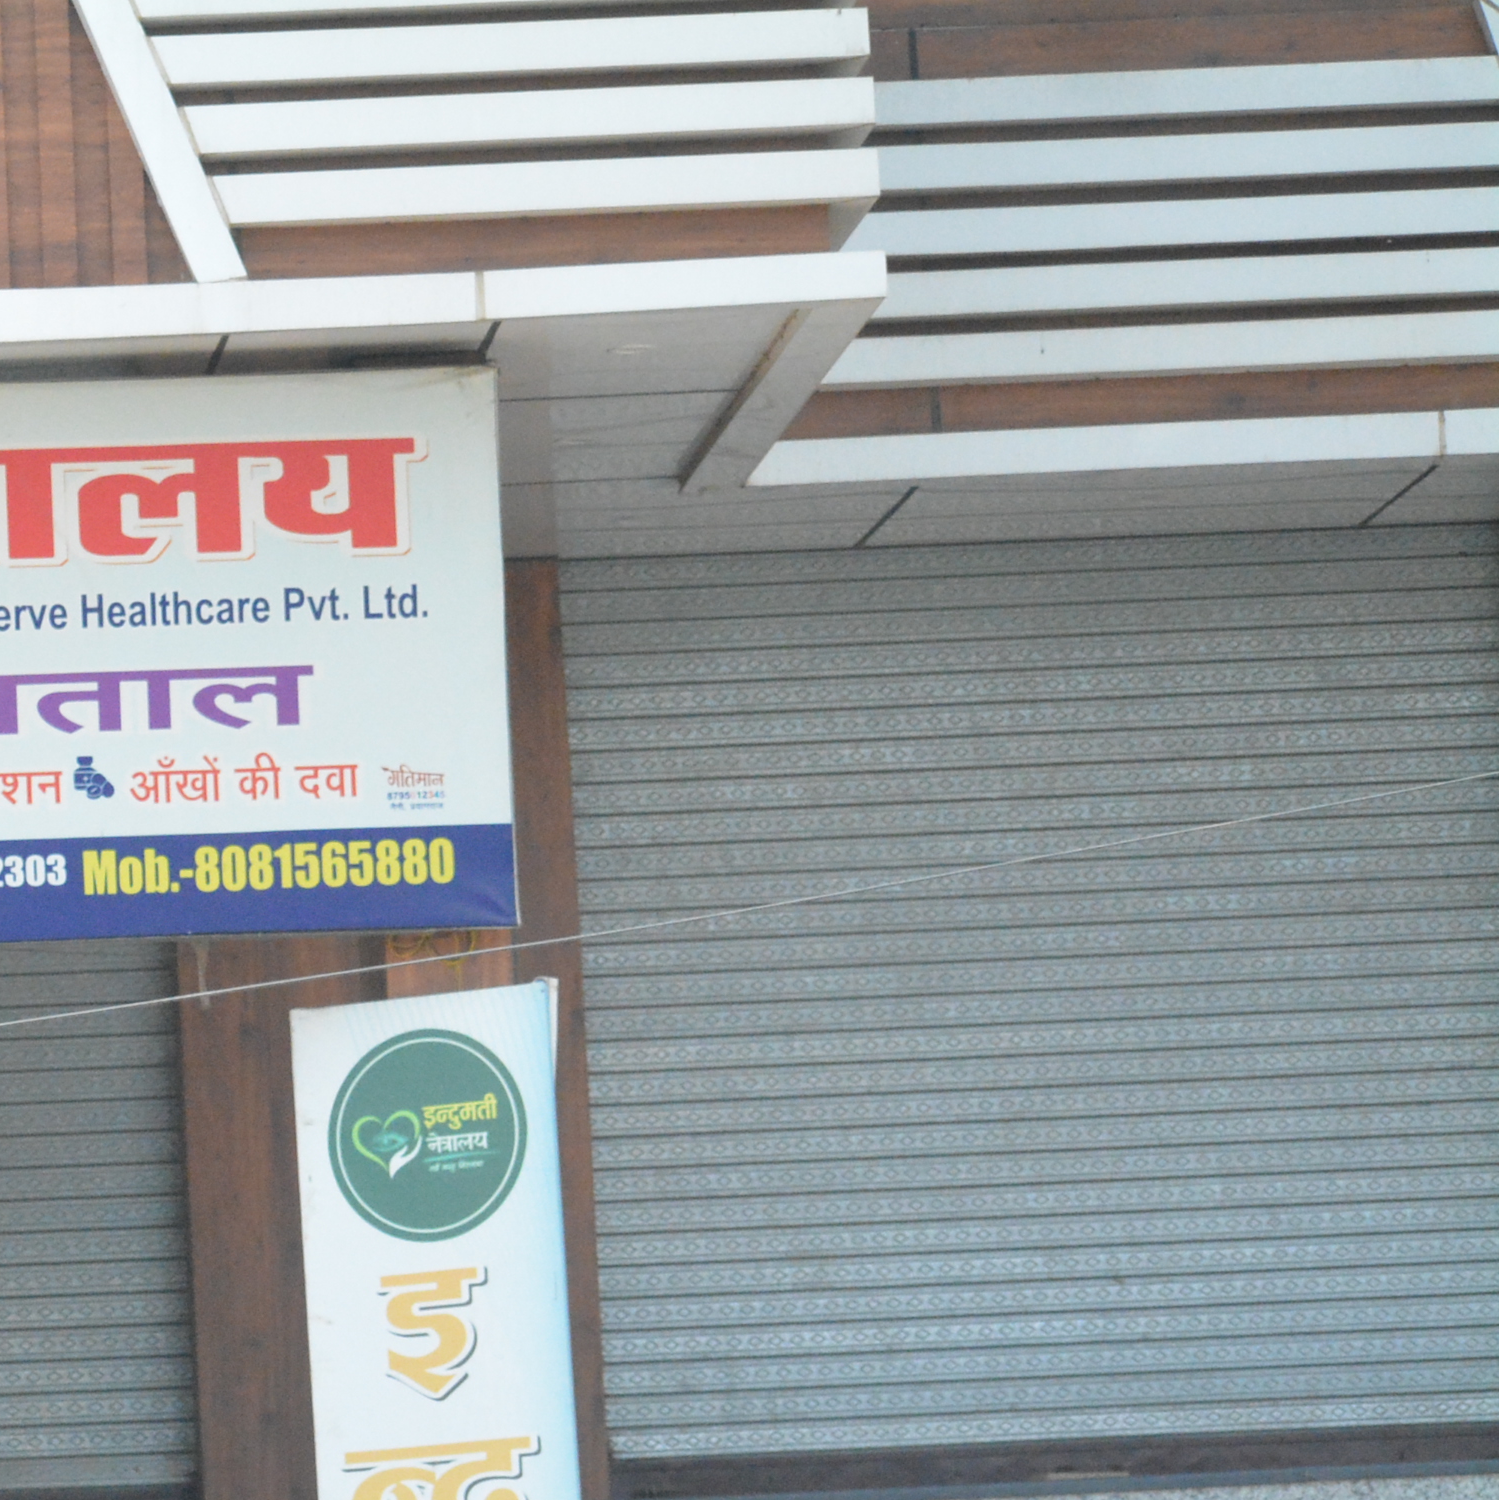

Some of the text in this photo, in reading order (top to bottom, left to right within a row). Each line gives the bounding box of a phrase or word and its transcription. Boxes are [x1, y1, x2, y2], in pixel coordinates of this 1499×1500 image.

[81, 591, 270, 629] Healthcare
[284, 587, 349, 622] Pvt.
[364, 583, 428, 620] Ltd.
[130, 752, 359, 803] आँखों की दवा
[83, 837, 455, 895] Mob.-8081565880
[422, 1092, 497, 1130] इन्दुमती
[426, 1132, 488, 1153] नेत्रालय
